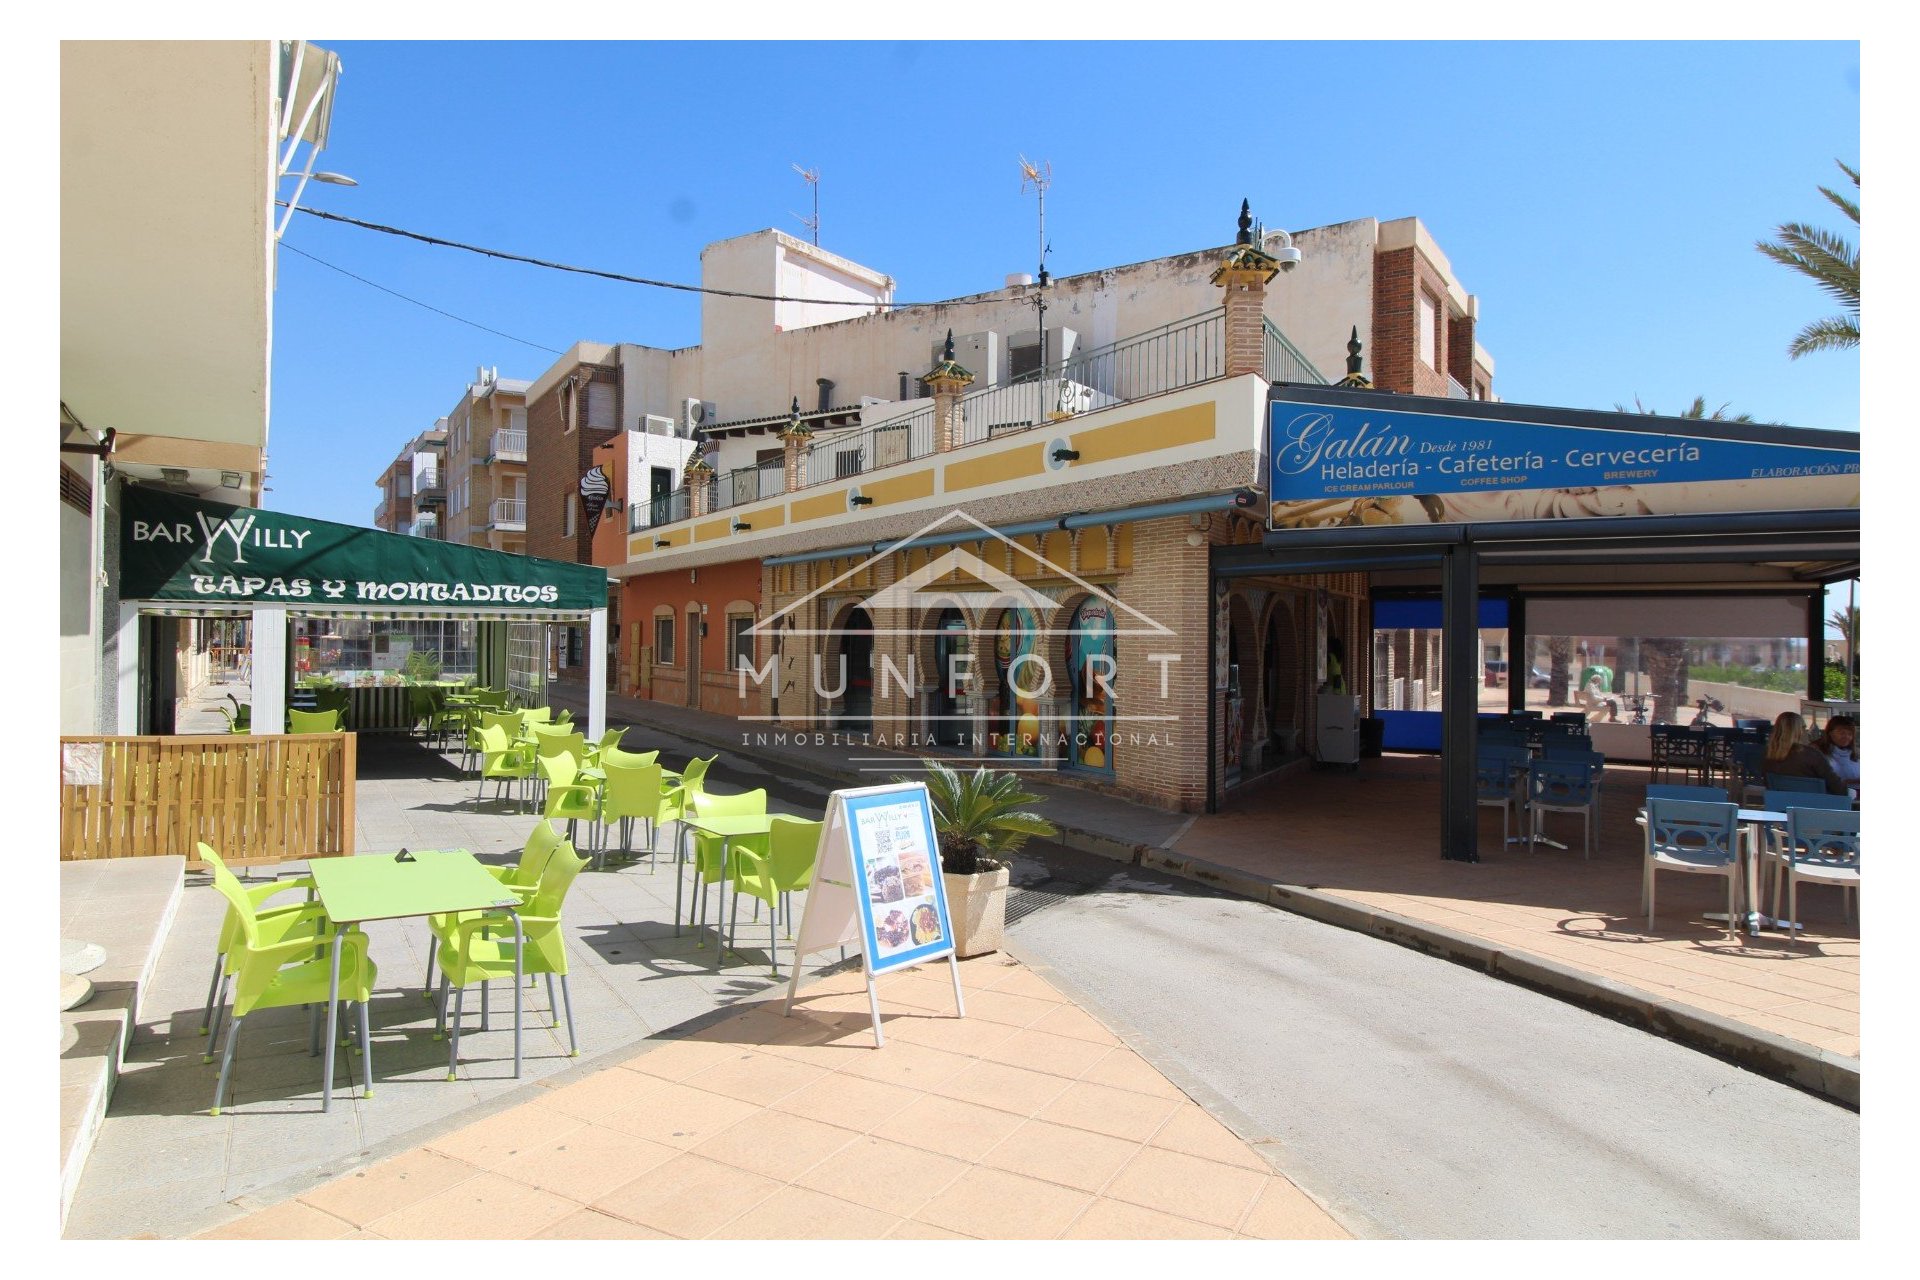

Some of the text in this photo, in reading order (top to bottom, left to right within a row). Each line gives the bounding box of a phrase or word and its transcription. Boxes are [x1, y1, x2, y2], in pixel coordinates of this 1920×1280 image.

[1277, 412, 1415, 475] Galán
[1420, 439, 1493, 454] Desde 1981
[1321, 459, 1419, 480] Heladería
[1438, 451, 1544, 475] Cafetería
[1565, 443, 1700, 468] Cervecería
[1603, 469, 1658, 480] BREWERY
[1751, 463, 1840, 478] ELABORACIÓN
[1324, 481, 1414, 492] ICE CREAM PARLOUR
[1460, 475, 1528, 486] COFFEE SHOP
[133, 511, 311, 564] BAR WILLY
[190, 573, 559, 602] TAPAS Y MONTADITOS
